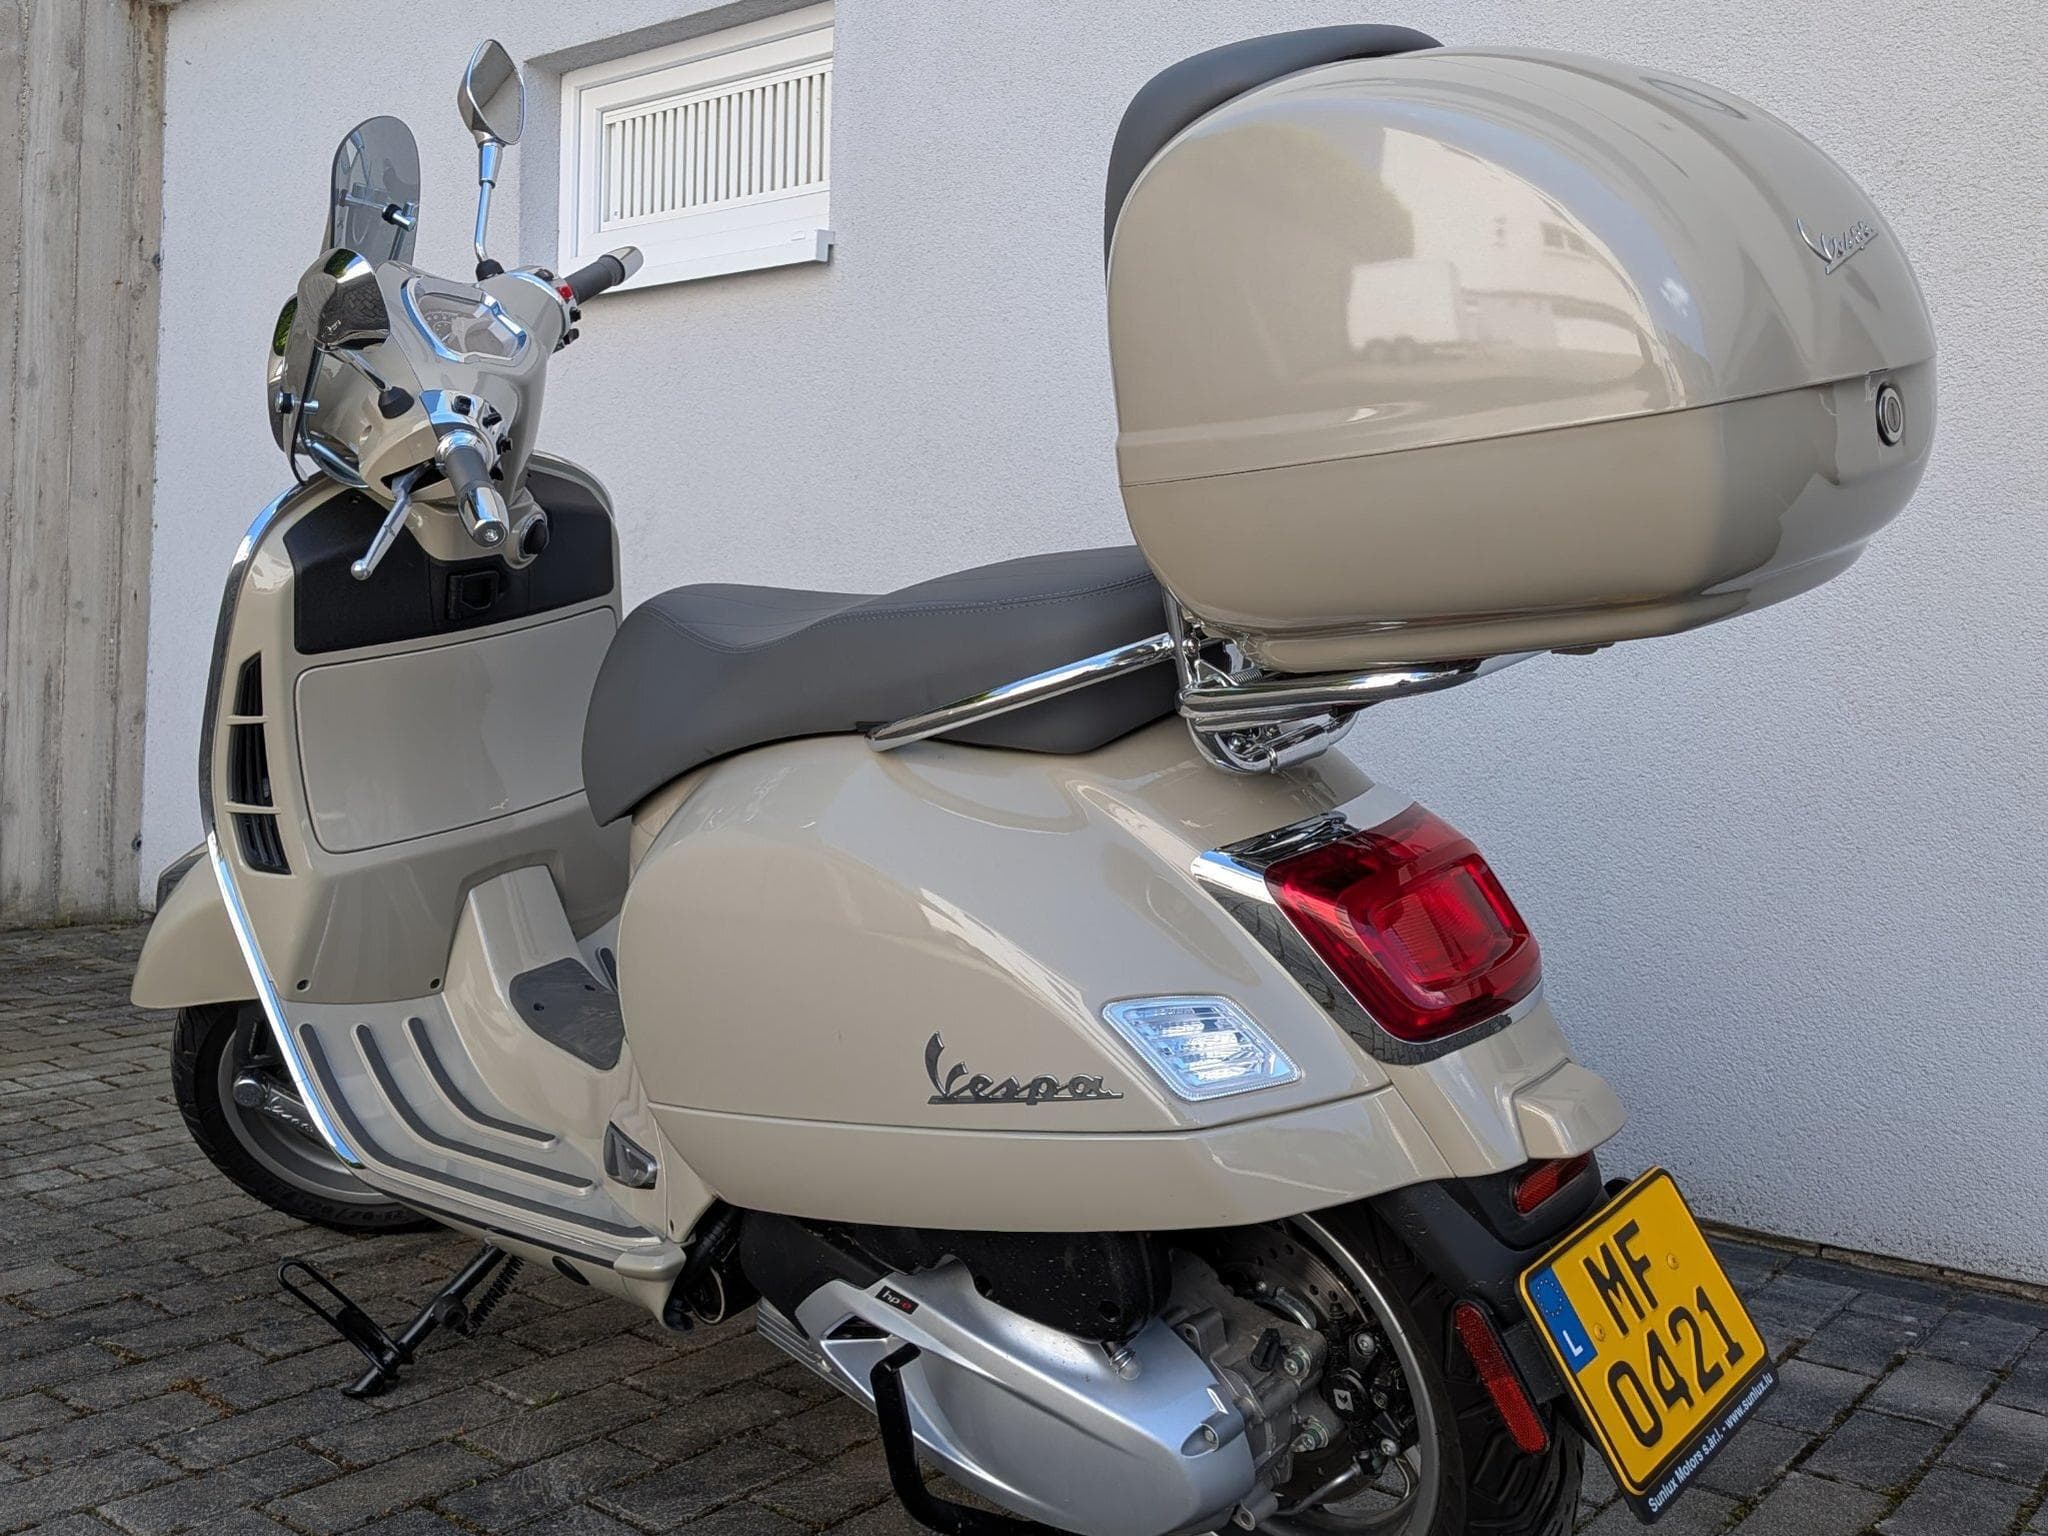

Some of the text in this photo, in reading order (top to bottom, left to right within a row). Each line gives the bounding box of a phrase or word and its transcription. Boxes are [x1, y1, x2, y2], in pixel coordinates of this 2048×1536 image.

[1797, 217, 1879, 275] Vespa
[925, 1031, 1124, 1105] Vespa
[1583, 1219, 1658, 1337] MF
[1563, 1330, 1583, 1356] L
[1607, 1286, 1744, 1448] 0421
[1648, 1478, 1678, 1512] Sunlux
[1674, 1450, 1704, 1483] Motors
[1724, 1372, 1774, 1430] www.sunlux.lu
